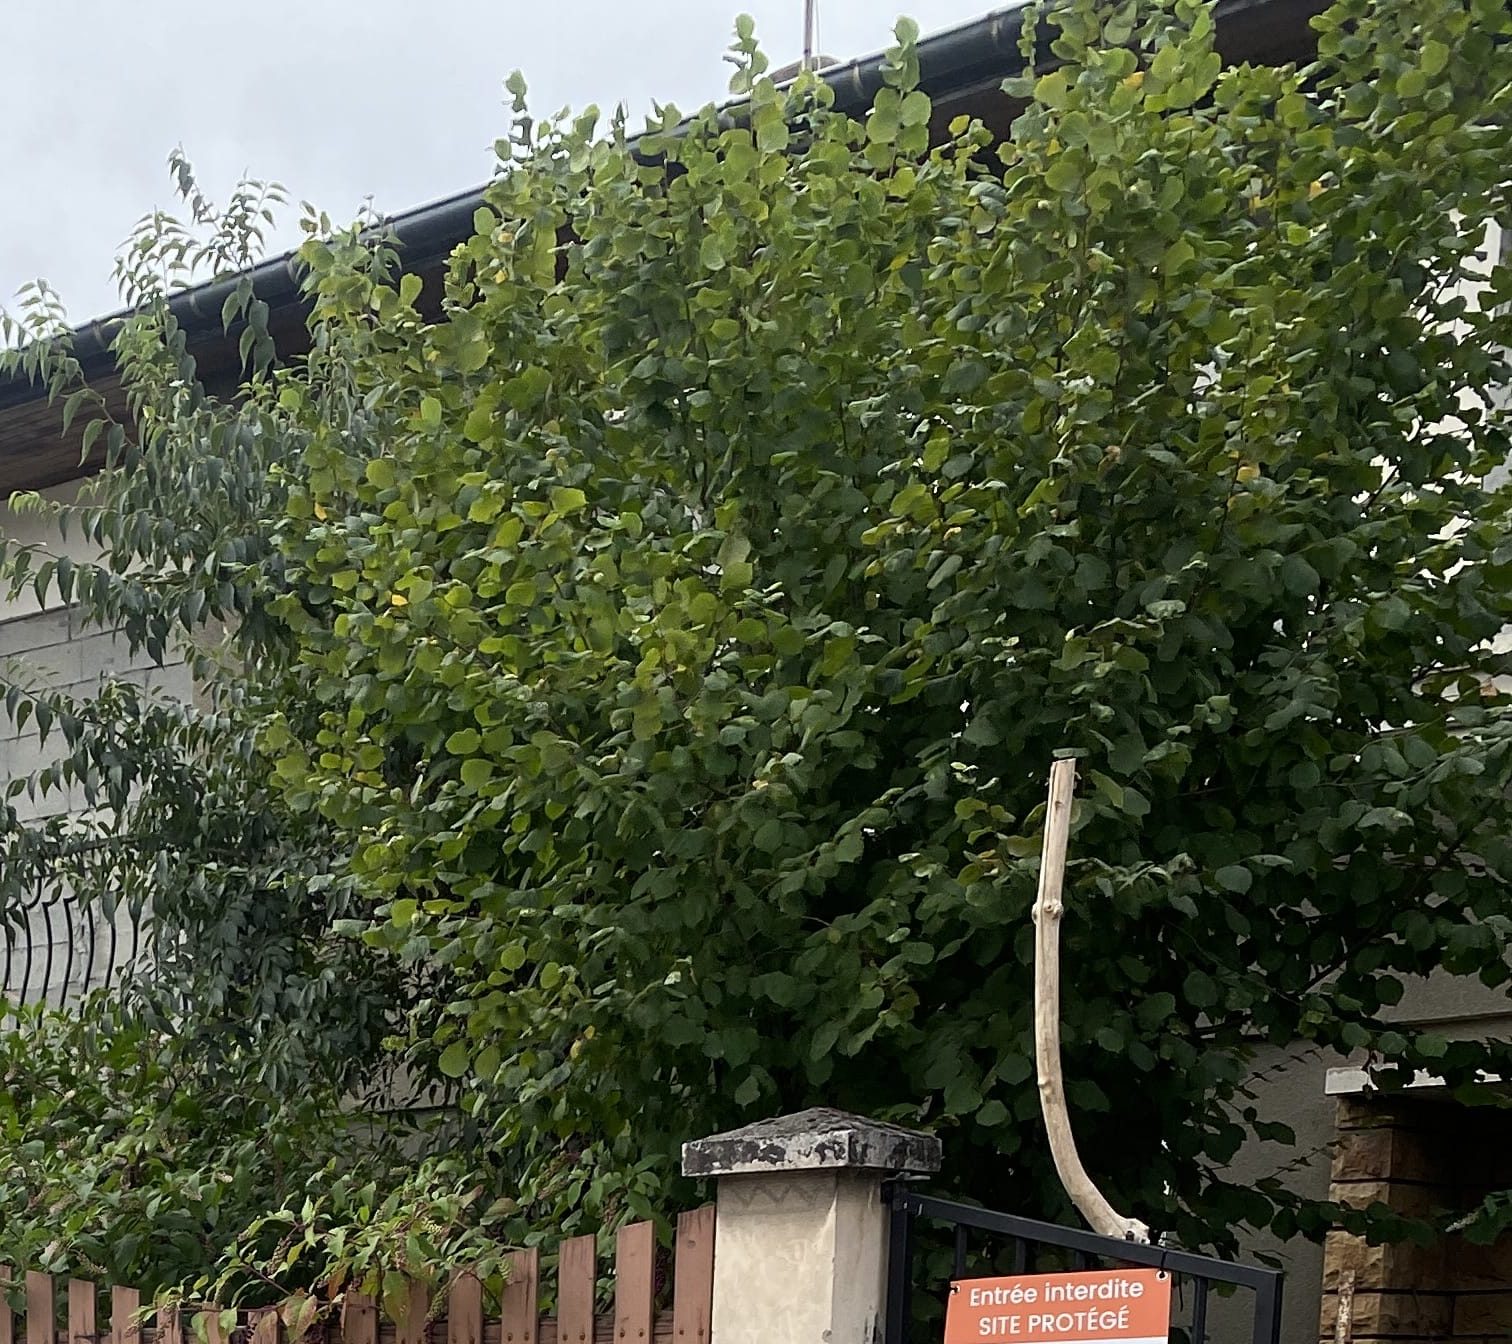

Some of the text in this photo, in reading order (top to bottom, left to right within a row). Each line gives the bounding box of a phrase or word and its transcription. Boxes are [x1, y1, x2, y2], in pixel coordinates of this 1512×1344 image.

[970, 1278, 1144, 1307] Entrée interdite
[979, 1305, 1130, 1336] SITE PROTÉGÉ
